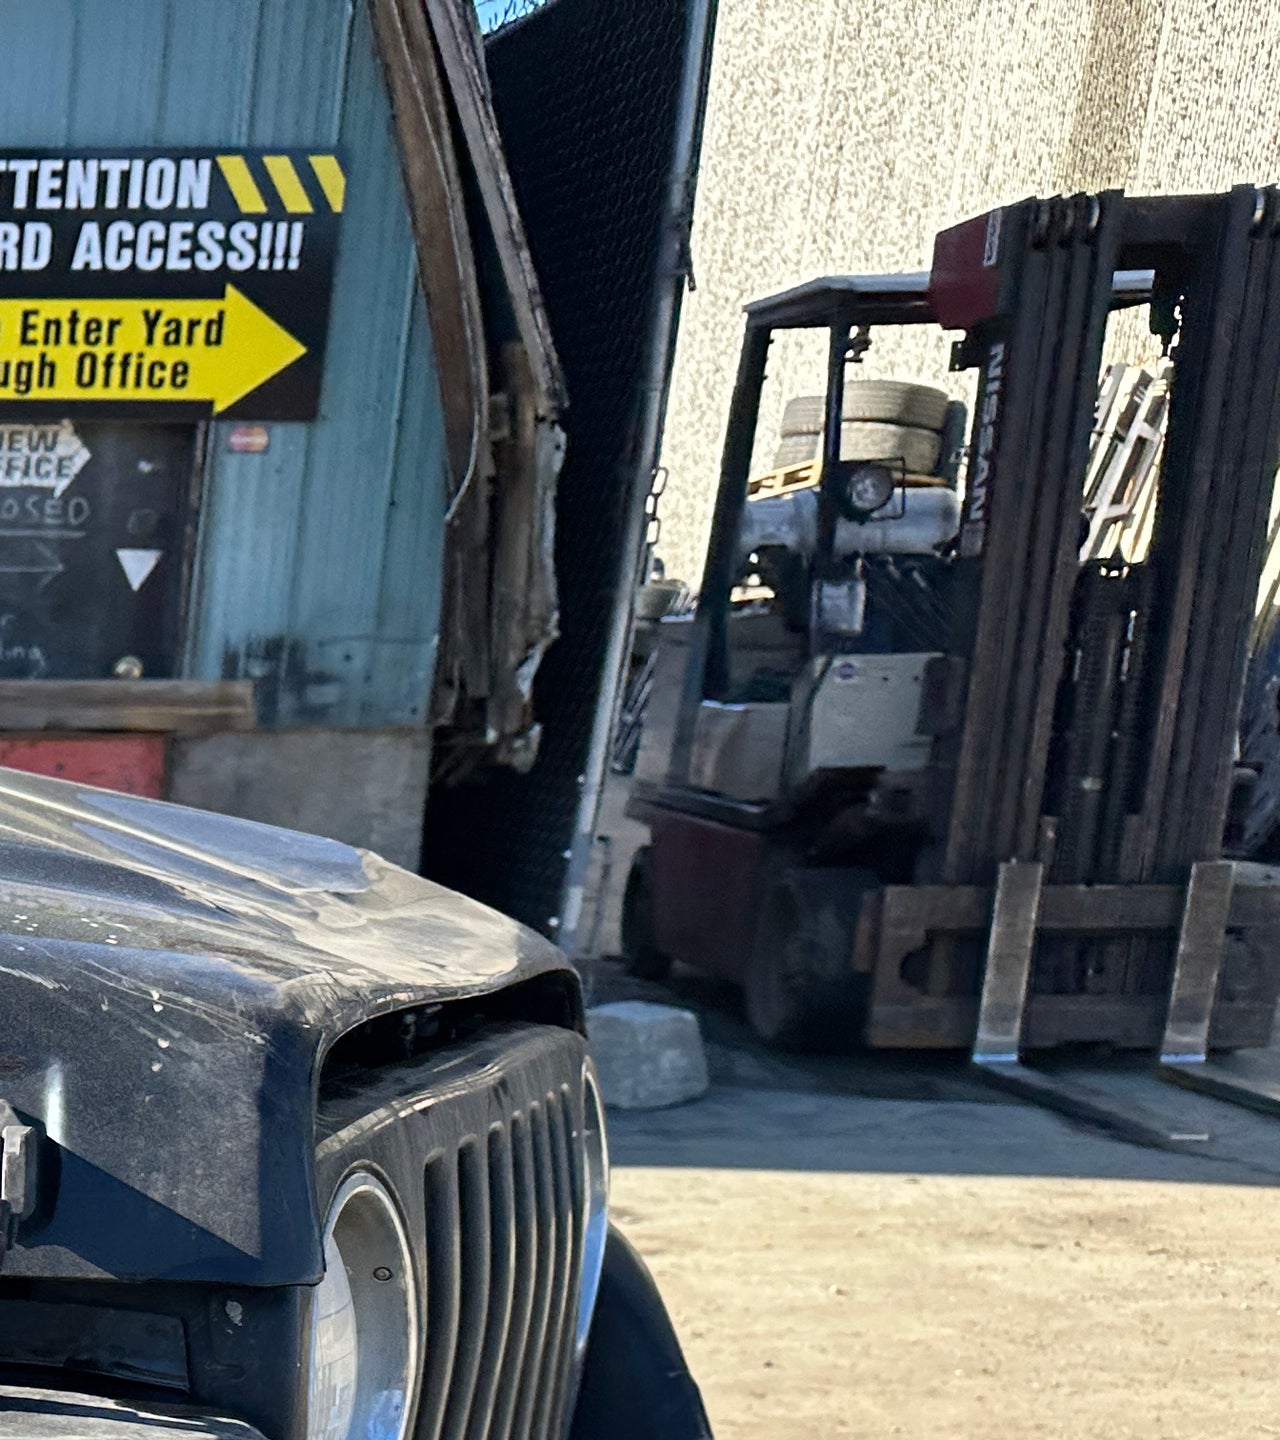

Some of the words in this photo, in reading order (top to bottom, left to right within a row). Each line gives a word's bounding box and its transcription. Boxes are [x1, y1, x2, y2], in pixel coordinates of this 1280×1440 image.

[72, 221, 304, 271] ACCESS!!!
[20, 309, 122, 346] Enter
[143, 309, 226, 347] Yard
[76, 352, 189, 389] Office
[968, 342, 1005, 520] NISSAN
